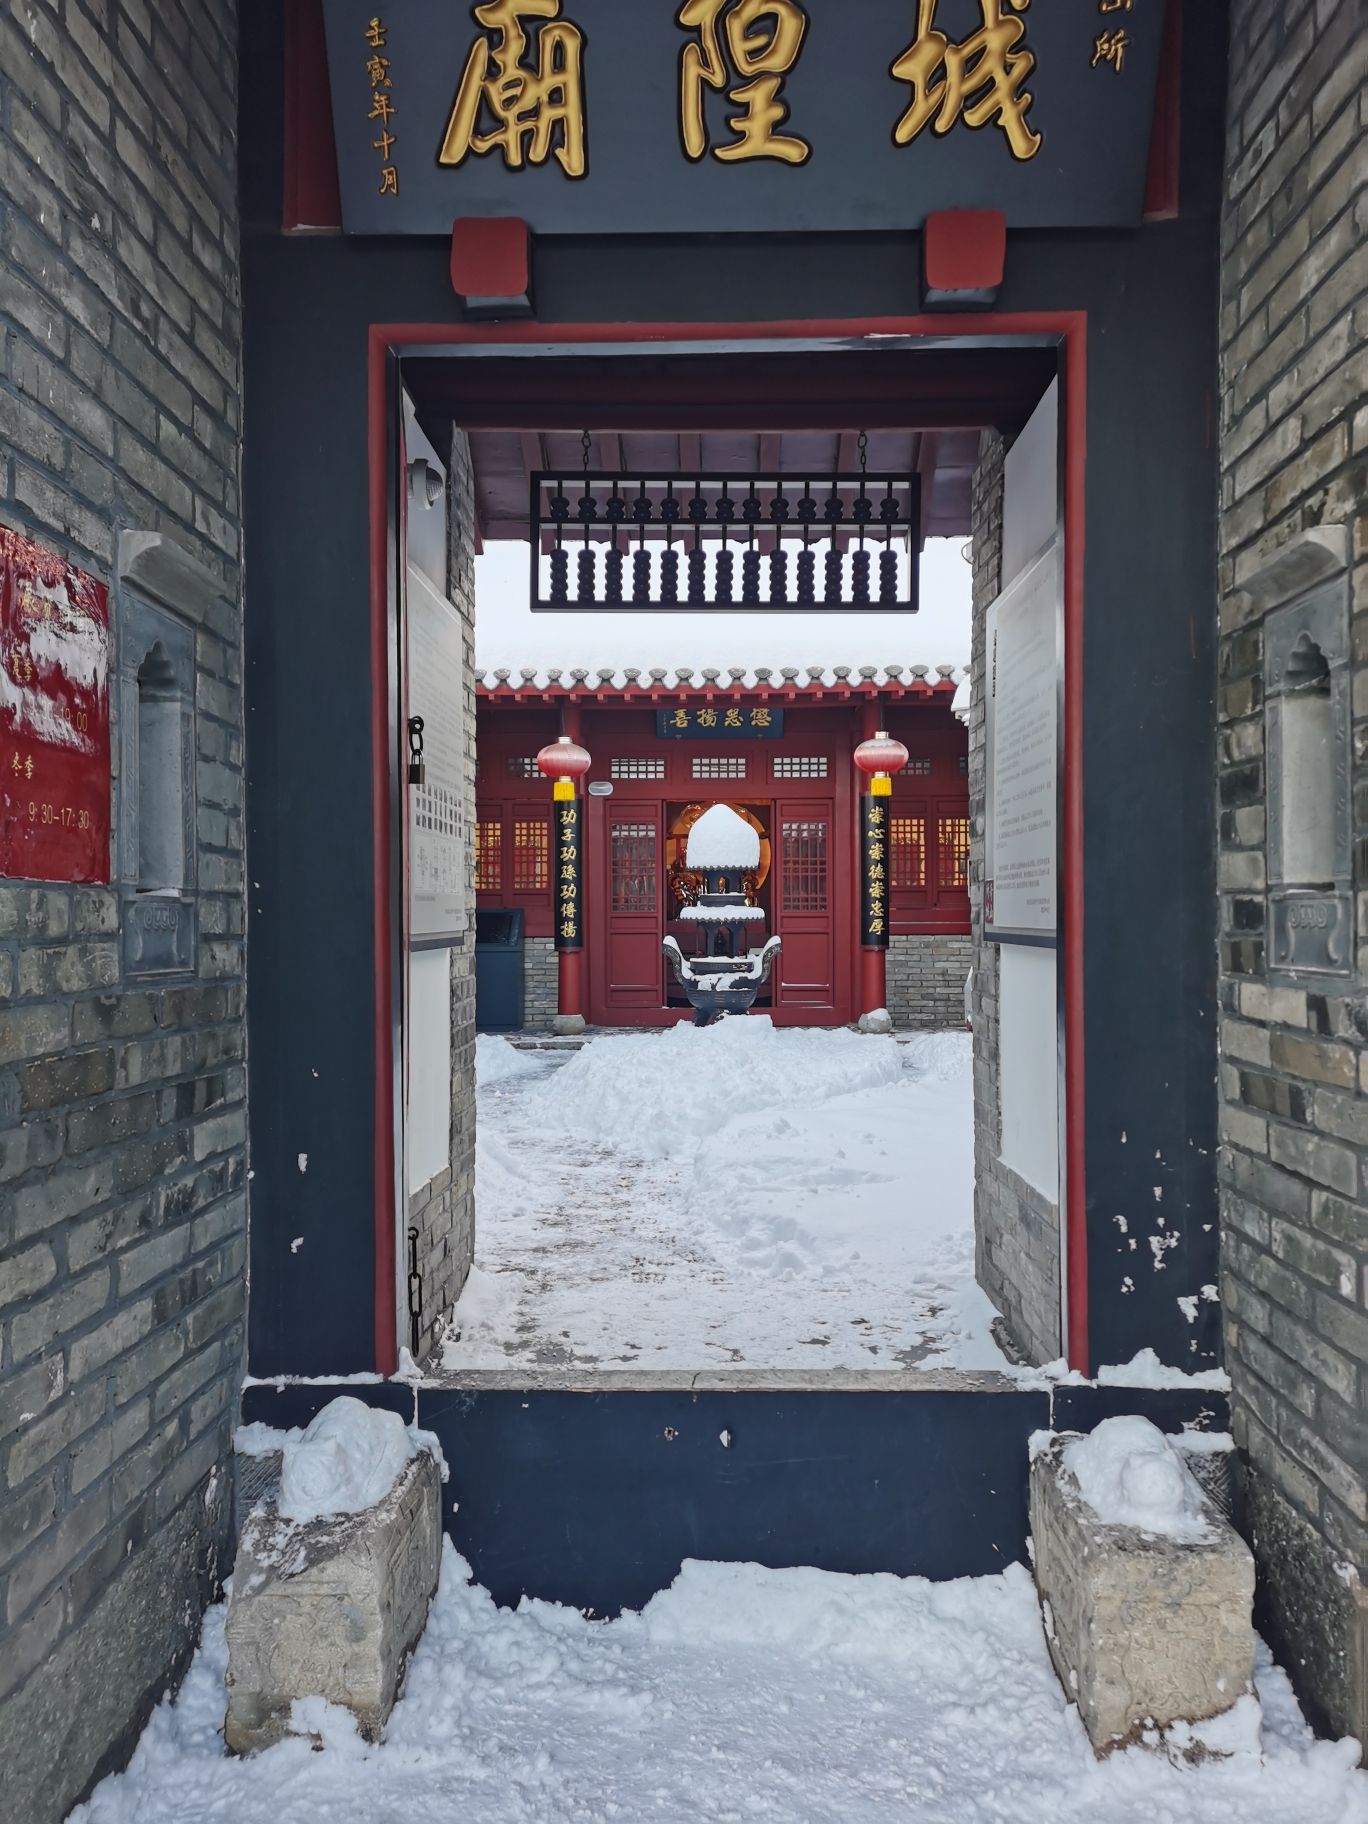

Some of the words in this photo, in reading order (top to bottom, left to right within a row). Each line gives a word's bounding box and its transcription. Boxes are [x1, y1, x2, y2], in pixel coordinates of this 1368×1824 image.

[366, 16, 398, 194] 壬寅年十月
[11, 751, 34, 779] 冬季
[28, 801, 90, 829] 9:30-17:30
